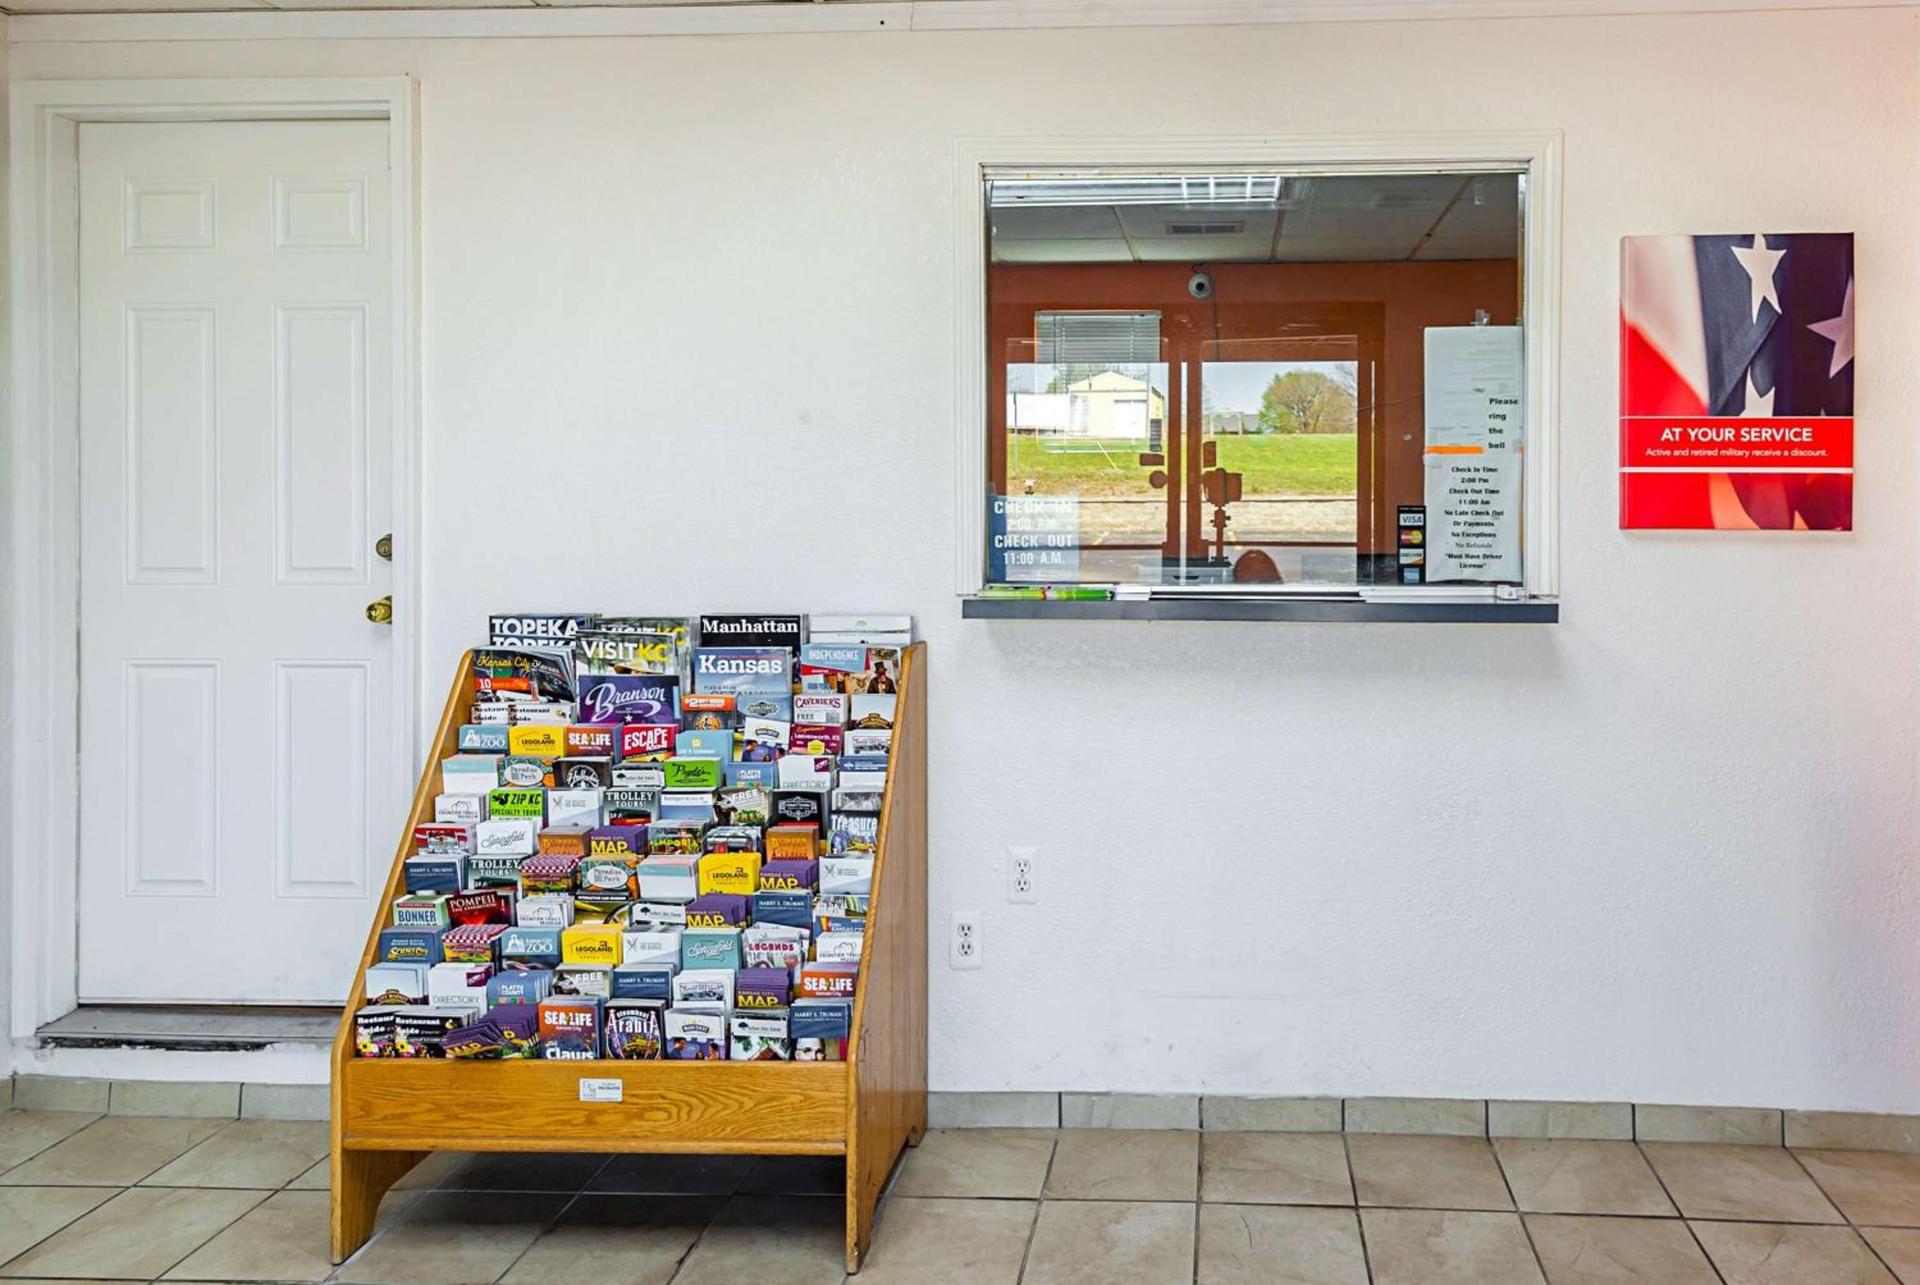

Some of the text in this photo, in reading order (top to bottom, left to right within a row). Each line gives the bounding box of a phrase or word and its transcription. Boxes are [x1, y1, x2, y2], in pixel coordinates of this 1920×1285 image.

[1489, 397, 1519, 405] Please
[1488, 413, 1507, 421] ring
[1488, 427, 1504, 435] the
[1660, 427, 1813, 442] AT YOUR SERVICE
[1488, 441, 1505, 449] bell
[1645, 447, 1671, 457] Active
[1673, 447, 1690, 457] and
[1690, 447, 1718, 457] retired
[1719, 447, 1750, 459] military
[1752, 448, 1782, 457] receive
[1790, 447, 1829, 457] discount.
[1402, 515, 1423, 523] VISA
[994, 534, 1073, 548] CHECK OUT
[1003, 551, 1065, 565] 11:00 A.M.
[491, 618, 579, 637] TOPEKA
[702, 618, 799, 634] Manhattan
[698, 654, 783, 674] Kansas
[479, 679, 492, 689] 10
[584, 682, 666, 723] Branson
[481, 738, 505, 748] ZOO
[521, 738, 555, 746] LEGOLAND
[568, 733, 612, 746] SEA LIFE
[623, 728, 669, 751] ESCAPE
[510, 793, 541, 805] ZIP KC
[605, 791, 655, 801] TROLLEY
[731, 788, 760, 801] FREE
[491, 807, 541, 816] SPECIALTY TOURS
[591, 841, 628, 855] MAP
[470, 859, 521, 869] TROLLEY
[760, 878, 799, 890] MAP
[450, 895, 497, 909] POMPEII
[397, 910, 437, 922] BONNER
[687, 915, 725, 927] MAP
[526, 942, 552, 952] ZOO
[575, 971, 604, 982] FREE
[803, 977, 854, 992] SEA LIFE
[431, 996, 480, 1004] DIRECTORY
[737, 995, 779, 1007] MAP
[357, 1015, 395, 1026] Restaur
[395, 1018, 441, 1026] Restaurant
[544, 1011, 593, 1026] SEA LIFE
